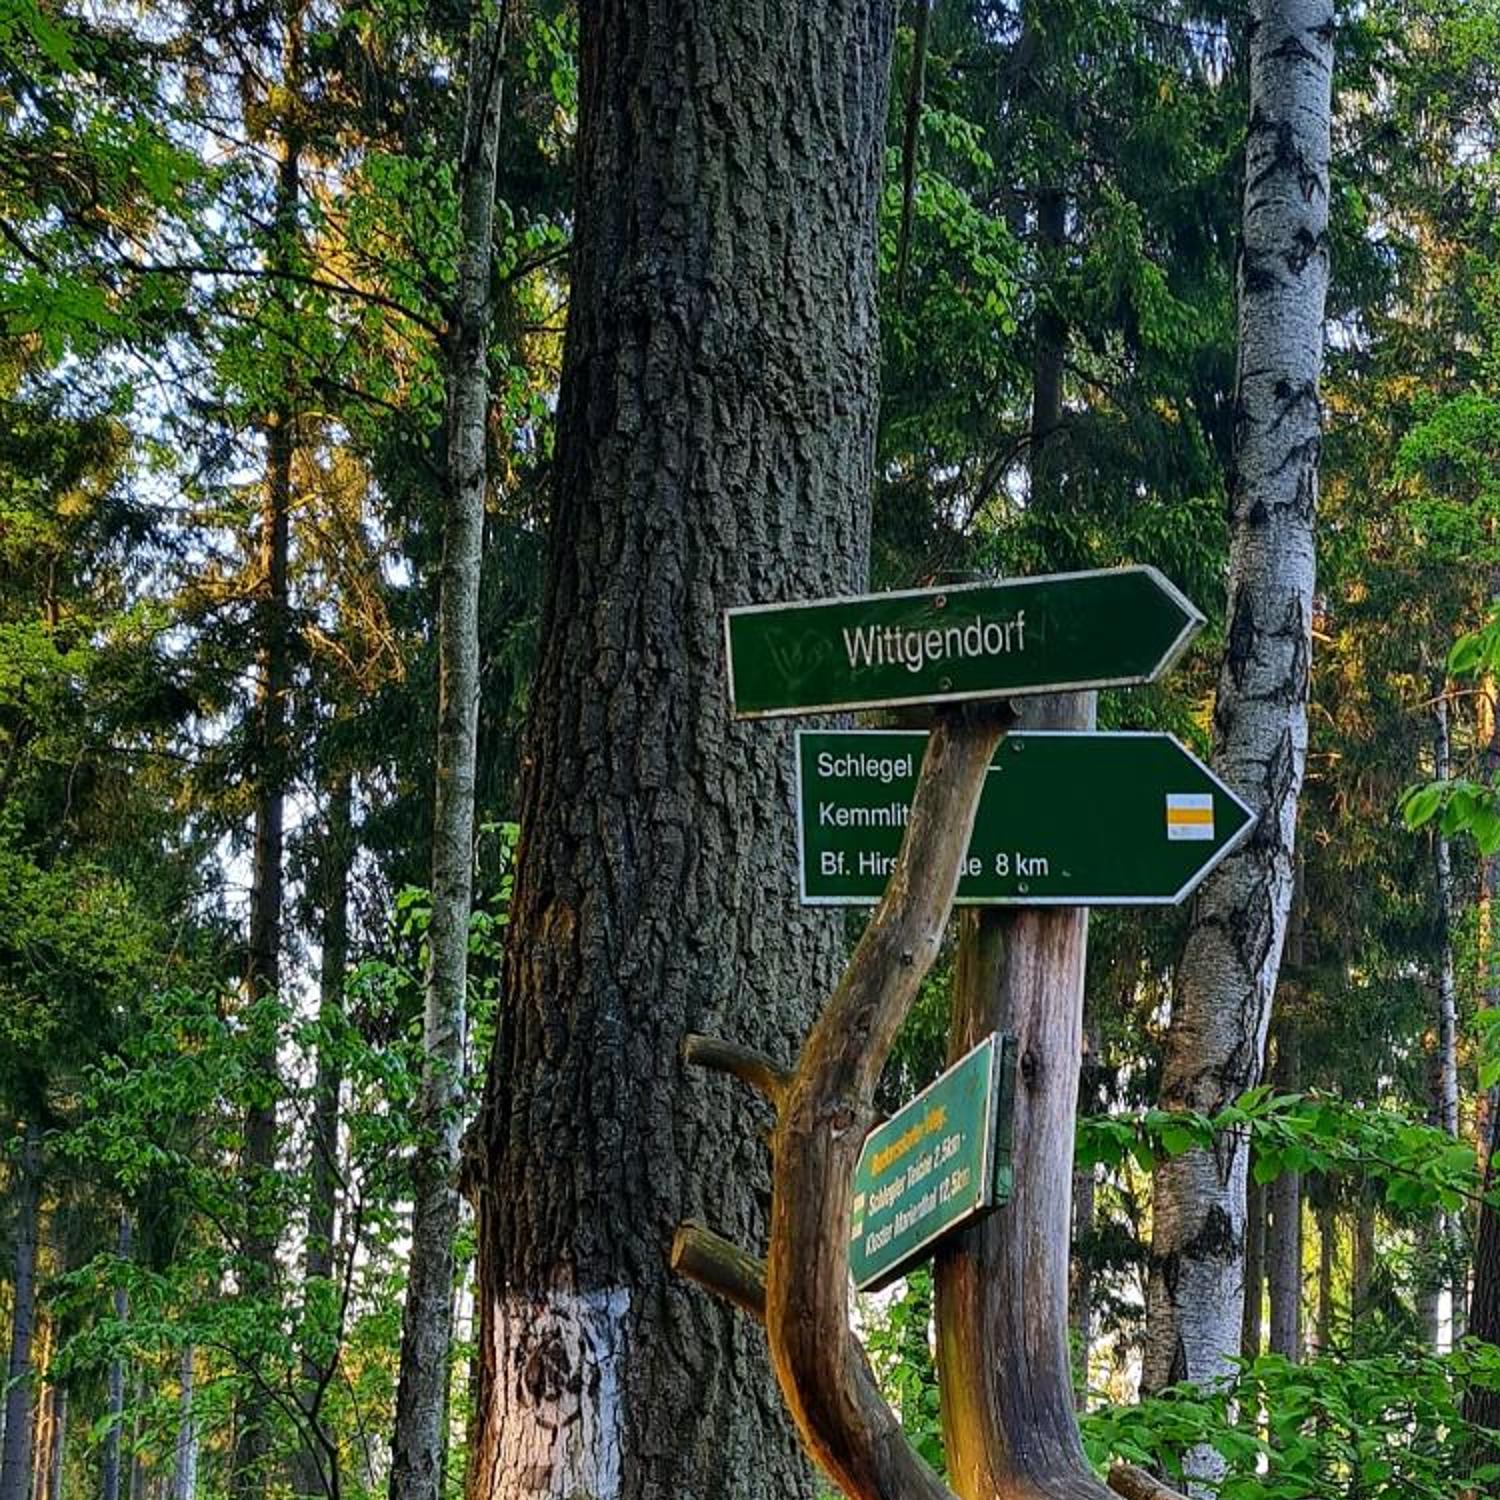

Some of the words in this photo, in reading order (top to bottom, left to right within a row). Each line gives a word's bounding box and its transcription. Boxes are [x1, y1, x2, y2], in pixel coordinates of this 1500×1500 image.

[842, 609, 1026, 674] Wittgendorf
[817, 752, 913, 783] Schlegel
[820, 851, 851, 876] Bf.
[995, 853, 1009, 877] 8
[1016, 851, 1049, 876] km
[865, 1221, 893, 1258] Kloster
